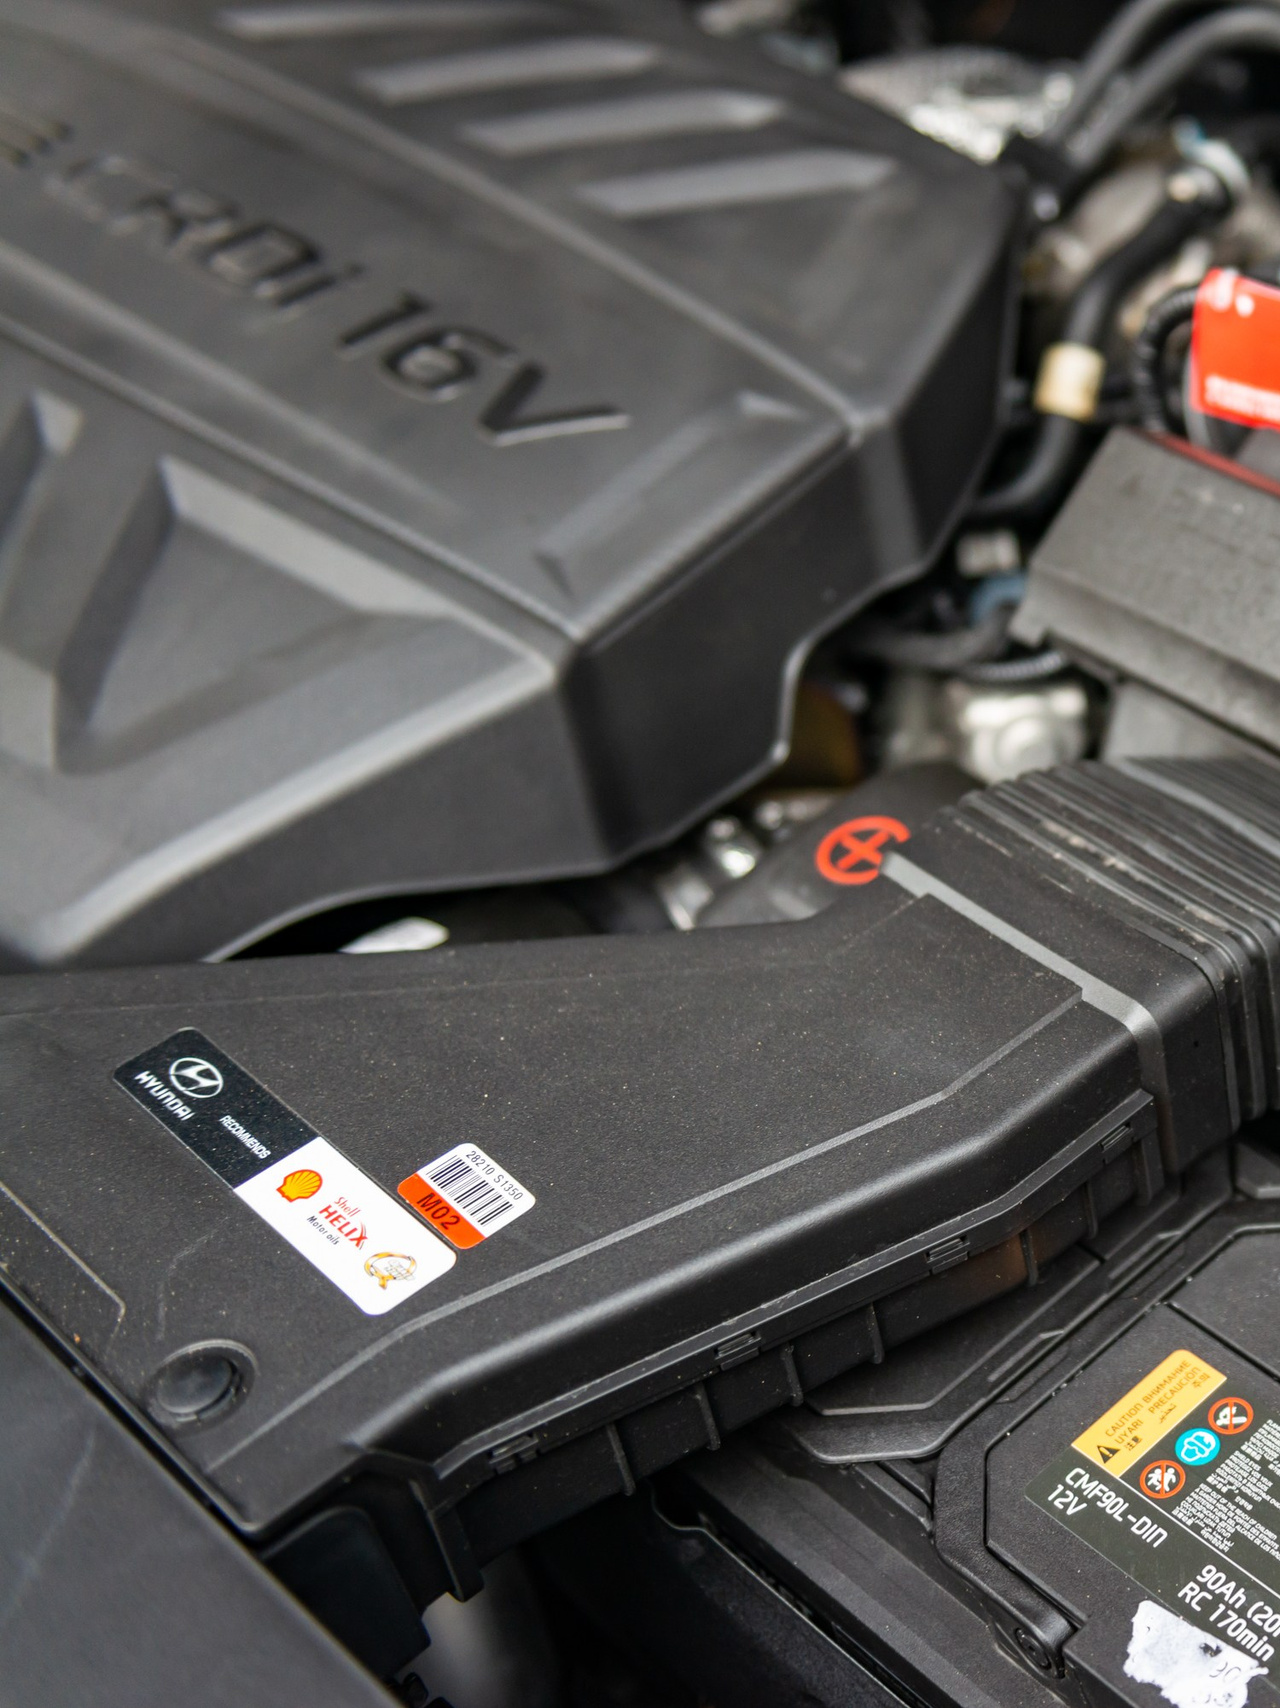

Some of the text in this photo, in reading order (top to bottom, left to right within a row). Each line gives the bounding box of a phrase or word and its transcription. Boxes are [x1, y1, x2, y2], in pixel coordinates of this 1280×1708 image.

[338, 291, 630, 446] 16V
[134, 1071, 196, 1121] HYUNDAI
[219, 1115, 271, 1160] RECOMMENDS
[466, 1150, 524, 1201] 28210 S1350
[318, 1204, 369, 1250] HELIX
[334, 1196, 361, 1217] Shell
[416, 1192, 461, 1231] M02
[307, 1215, 340, 1246] Motor oils
[1142, 1360, 1191, 1404] ВНИМАНИЕ
[1148, 1366, 1200, 1414] PRECAUCIÓN
[1106, 1402, 1143, 1437] CAUTION
[1114, 1418, 1143, 1445] UYARI
[1047, 1484, 1088, 1517] 12V
[1065, 1467, 1168, 1548] CMF90L-DIN
[1210, 1490, 1222, 1500] OUT
[1226, 1501, 1236, 1511] THE
[1196, 1564, 1247, 1609] 90Ah
[1178, 1581, 1275, 1662] RC 170min
